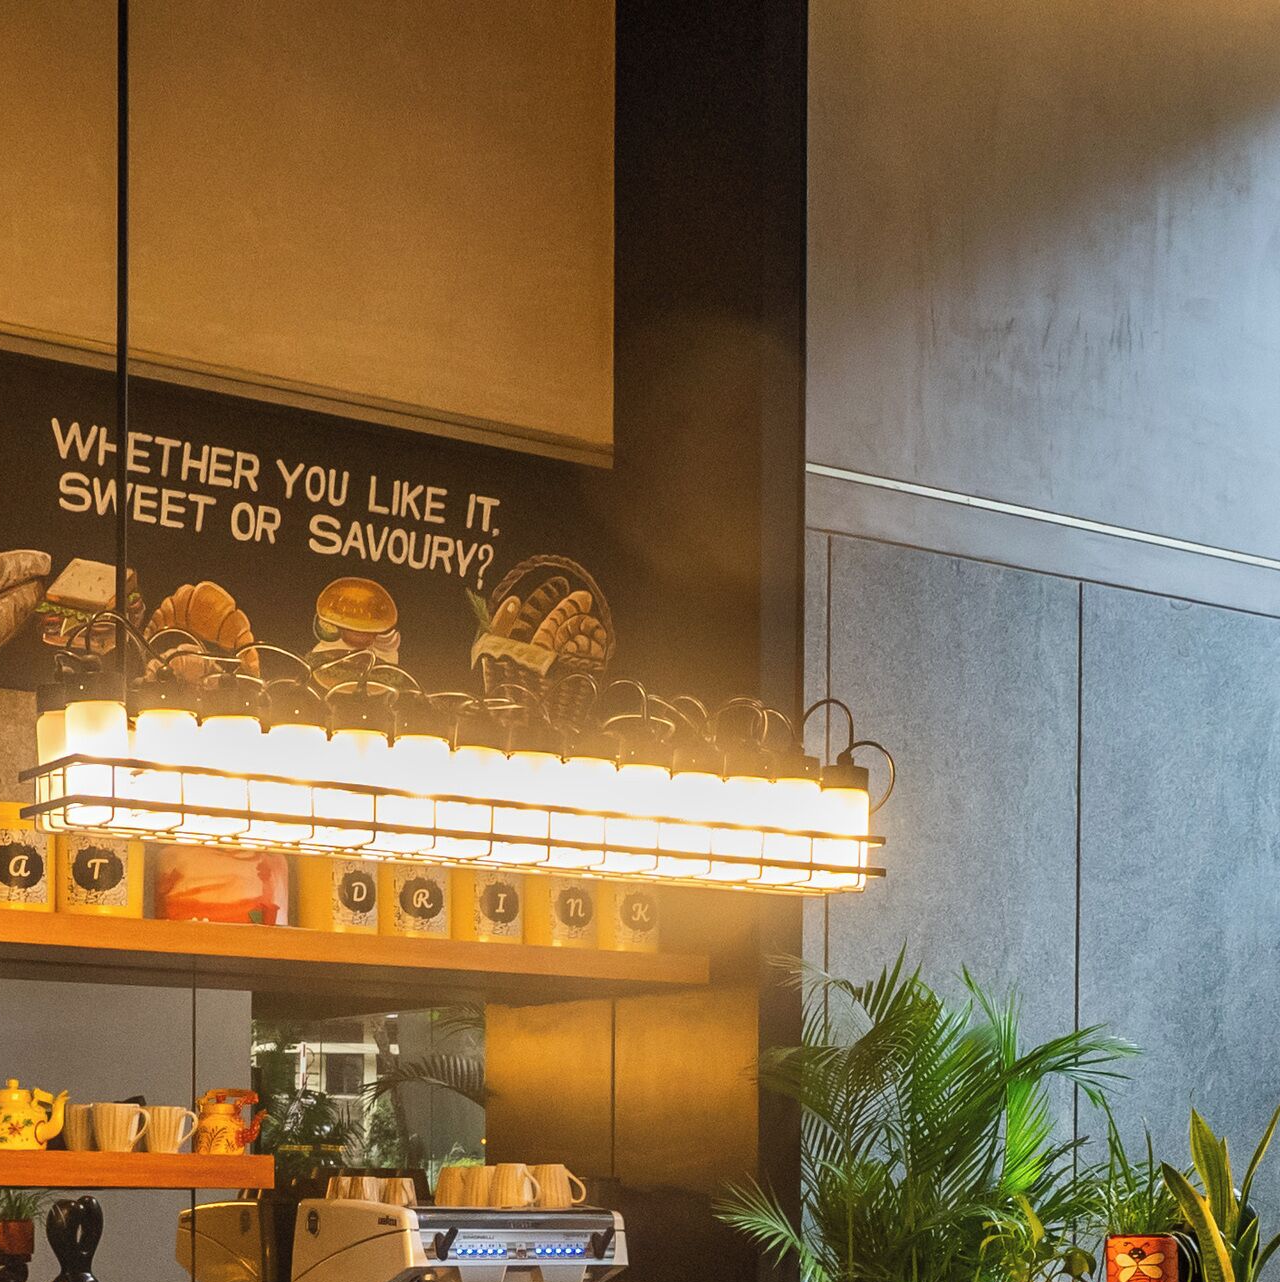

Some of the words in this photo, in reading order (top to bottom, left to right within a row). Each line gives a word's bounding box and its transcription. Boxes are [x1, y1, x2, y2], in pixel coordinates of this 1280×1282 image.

[51, 418, 260, 492] WHETHER
[276, 459, 350, 507] YOU
[368, 475, 447, 524] LIKE
[59, 472, 217, 533] SWEET
[231, 502, 281, 544] OR
[309, 514, 495, 590] SAVOURY?
